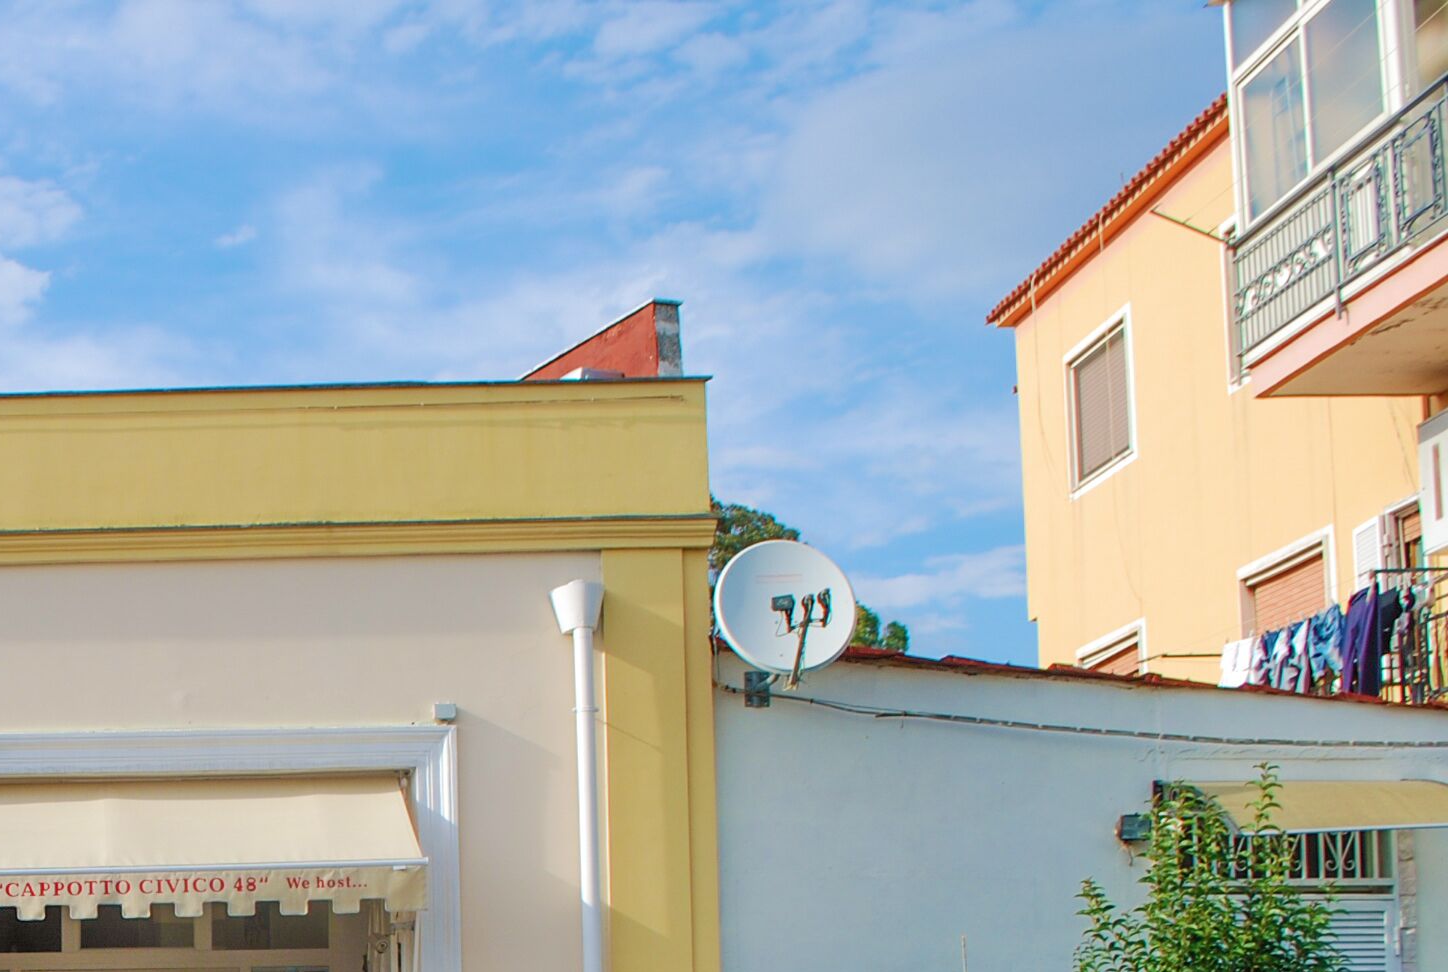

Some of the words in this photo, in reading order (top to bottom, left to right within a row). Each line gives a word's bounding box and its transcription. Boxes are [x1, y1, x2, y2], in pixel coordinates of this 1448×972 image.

[139, 877, 225, 894] CIVICO
[287, 876, 310, 889] We
[316, 876, 368, 889] host...
